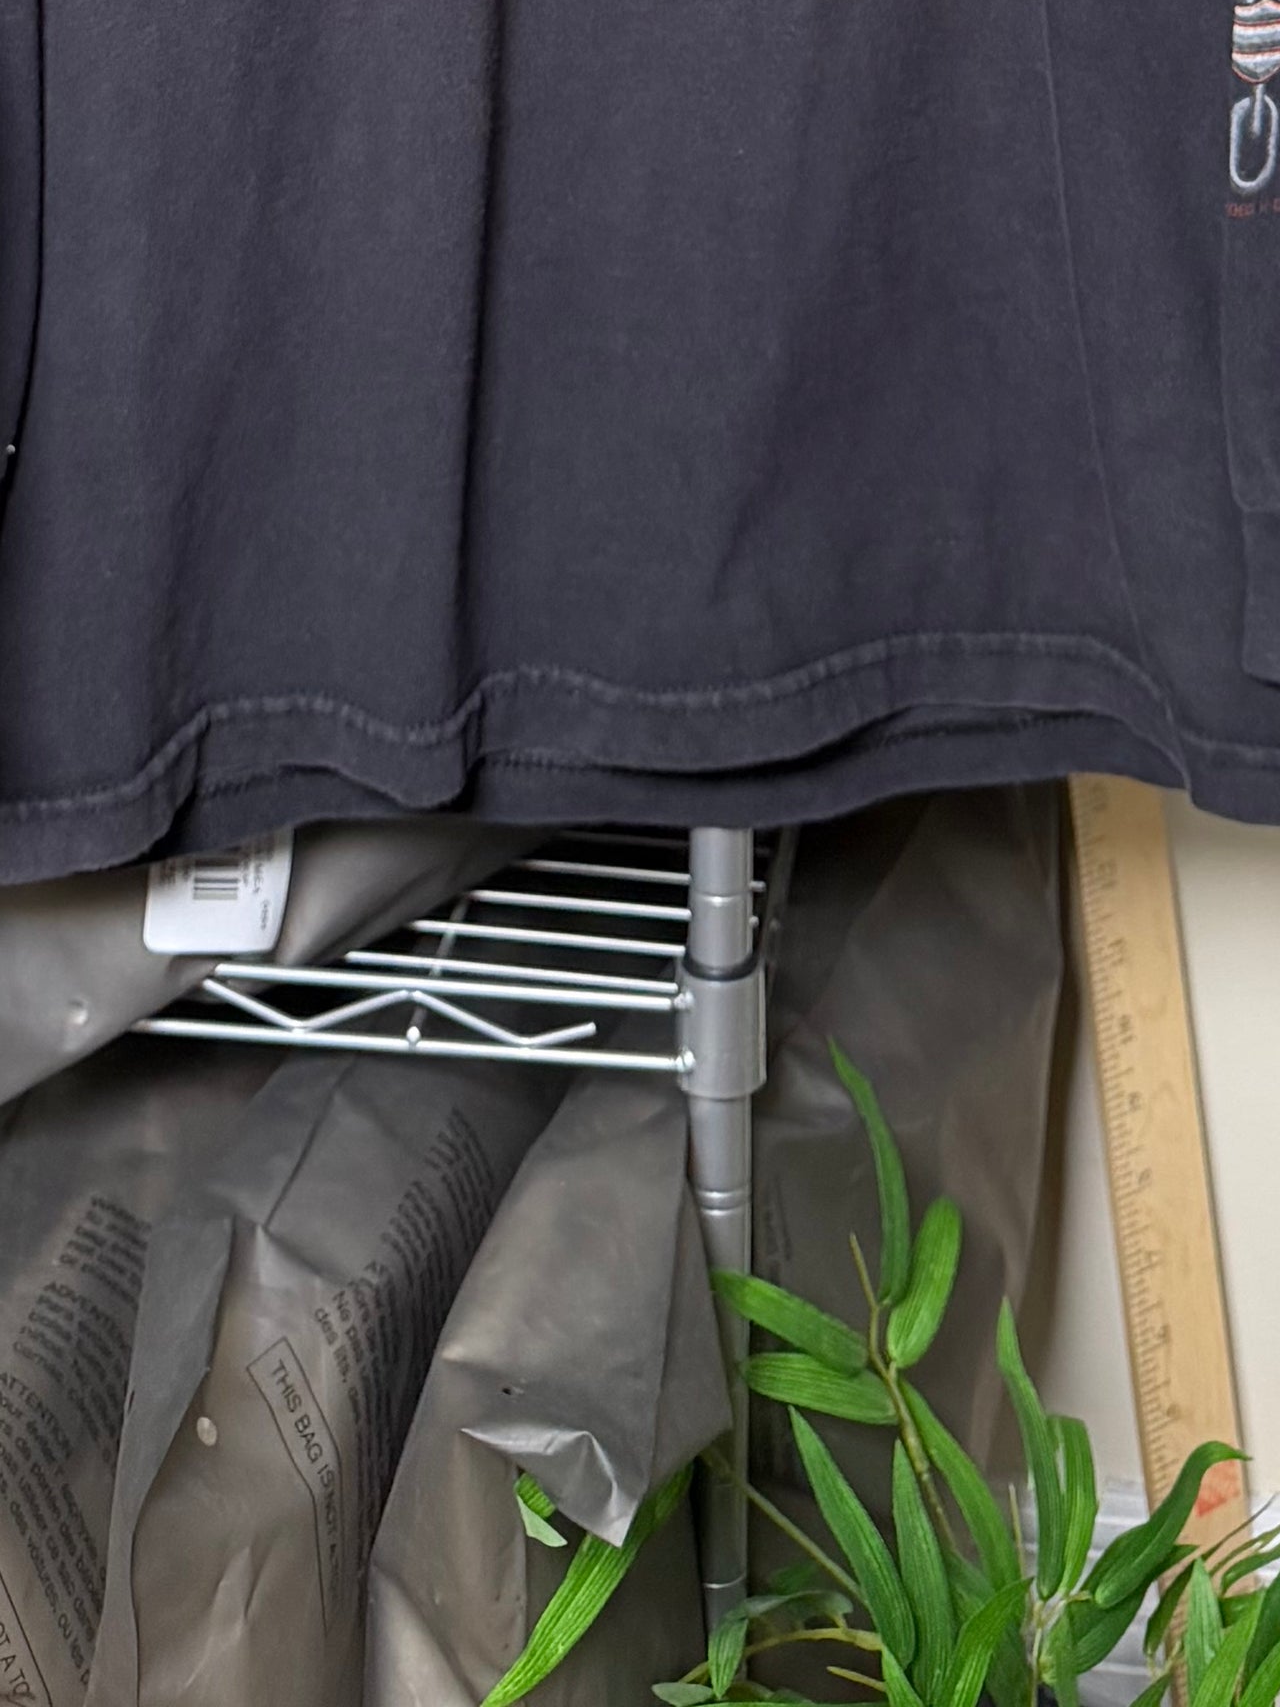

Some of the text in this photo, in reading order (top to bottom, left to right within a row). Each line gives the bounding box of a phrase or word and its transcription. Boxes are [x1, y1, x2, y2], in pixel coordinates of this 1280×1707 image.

[269, 1358, 304, 1414] THIS
[293, 1414, 324, 1466] BAG
[0, 1654, 17, 1673] A
